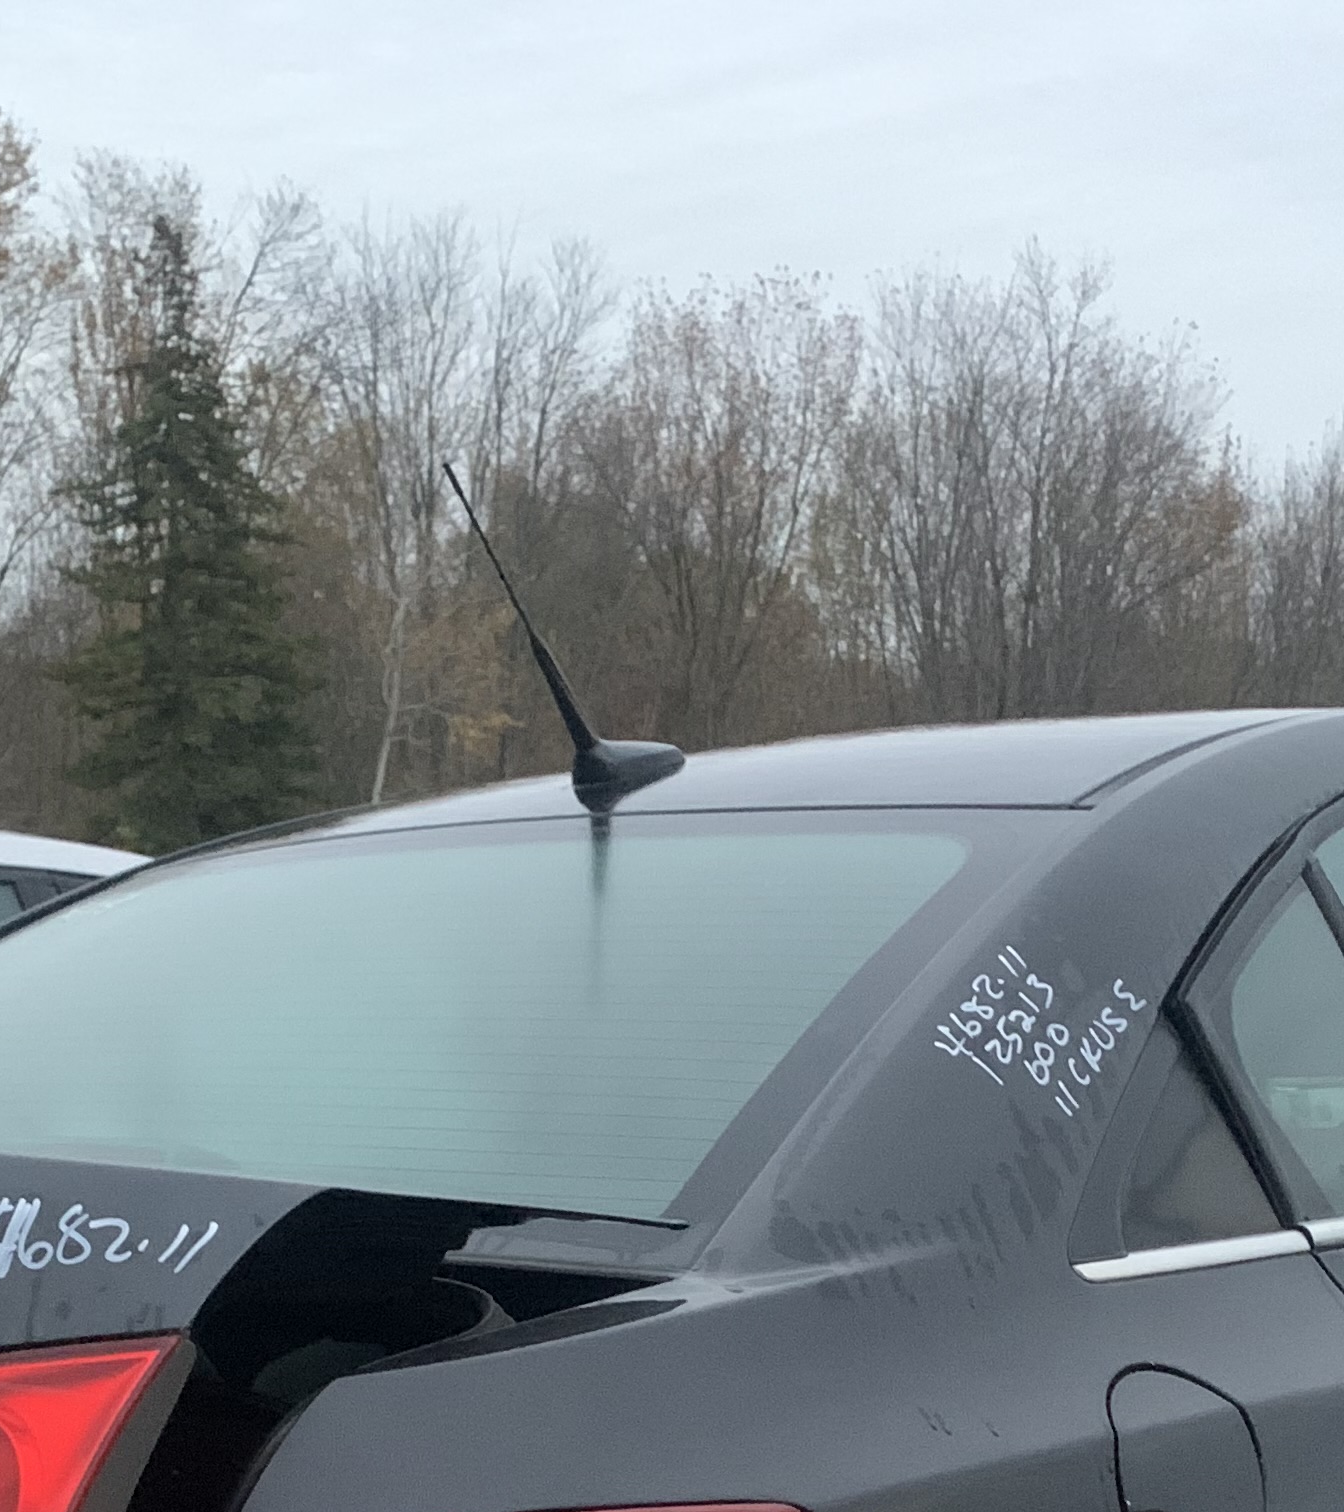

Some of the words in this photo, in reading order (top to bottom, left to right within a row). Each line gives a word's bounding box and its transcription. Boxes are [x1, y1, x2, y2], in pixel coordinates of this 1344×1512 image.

[934, 945, 1027, 1056] 4682.11
[972, 973, 1053, 1086] 125213
[1024, 1023, 1069, 1086] 600
